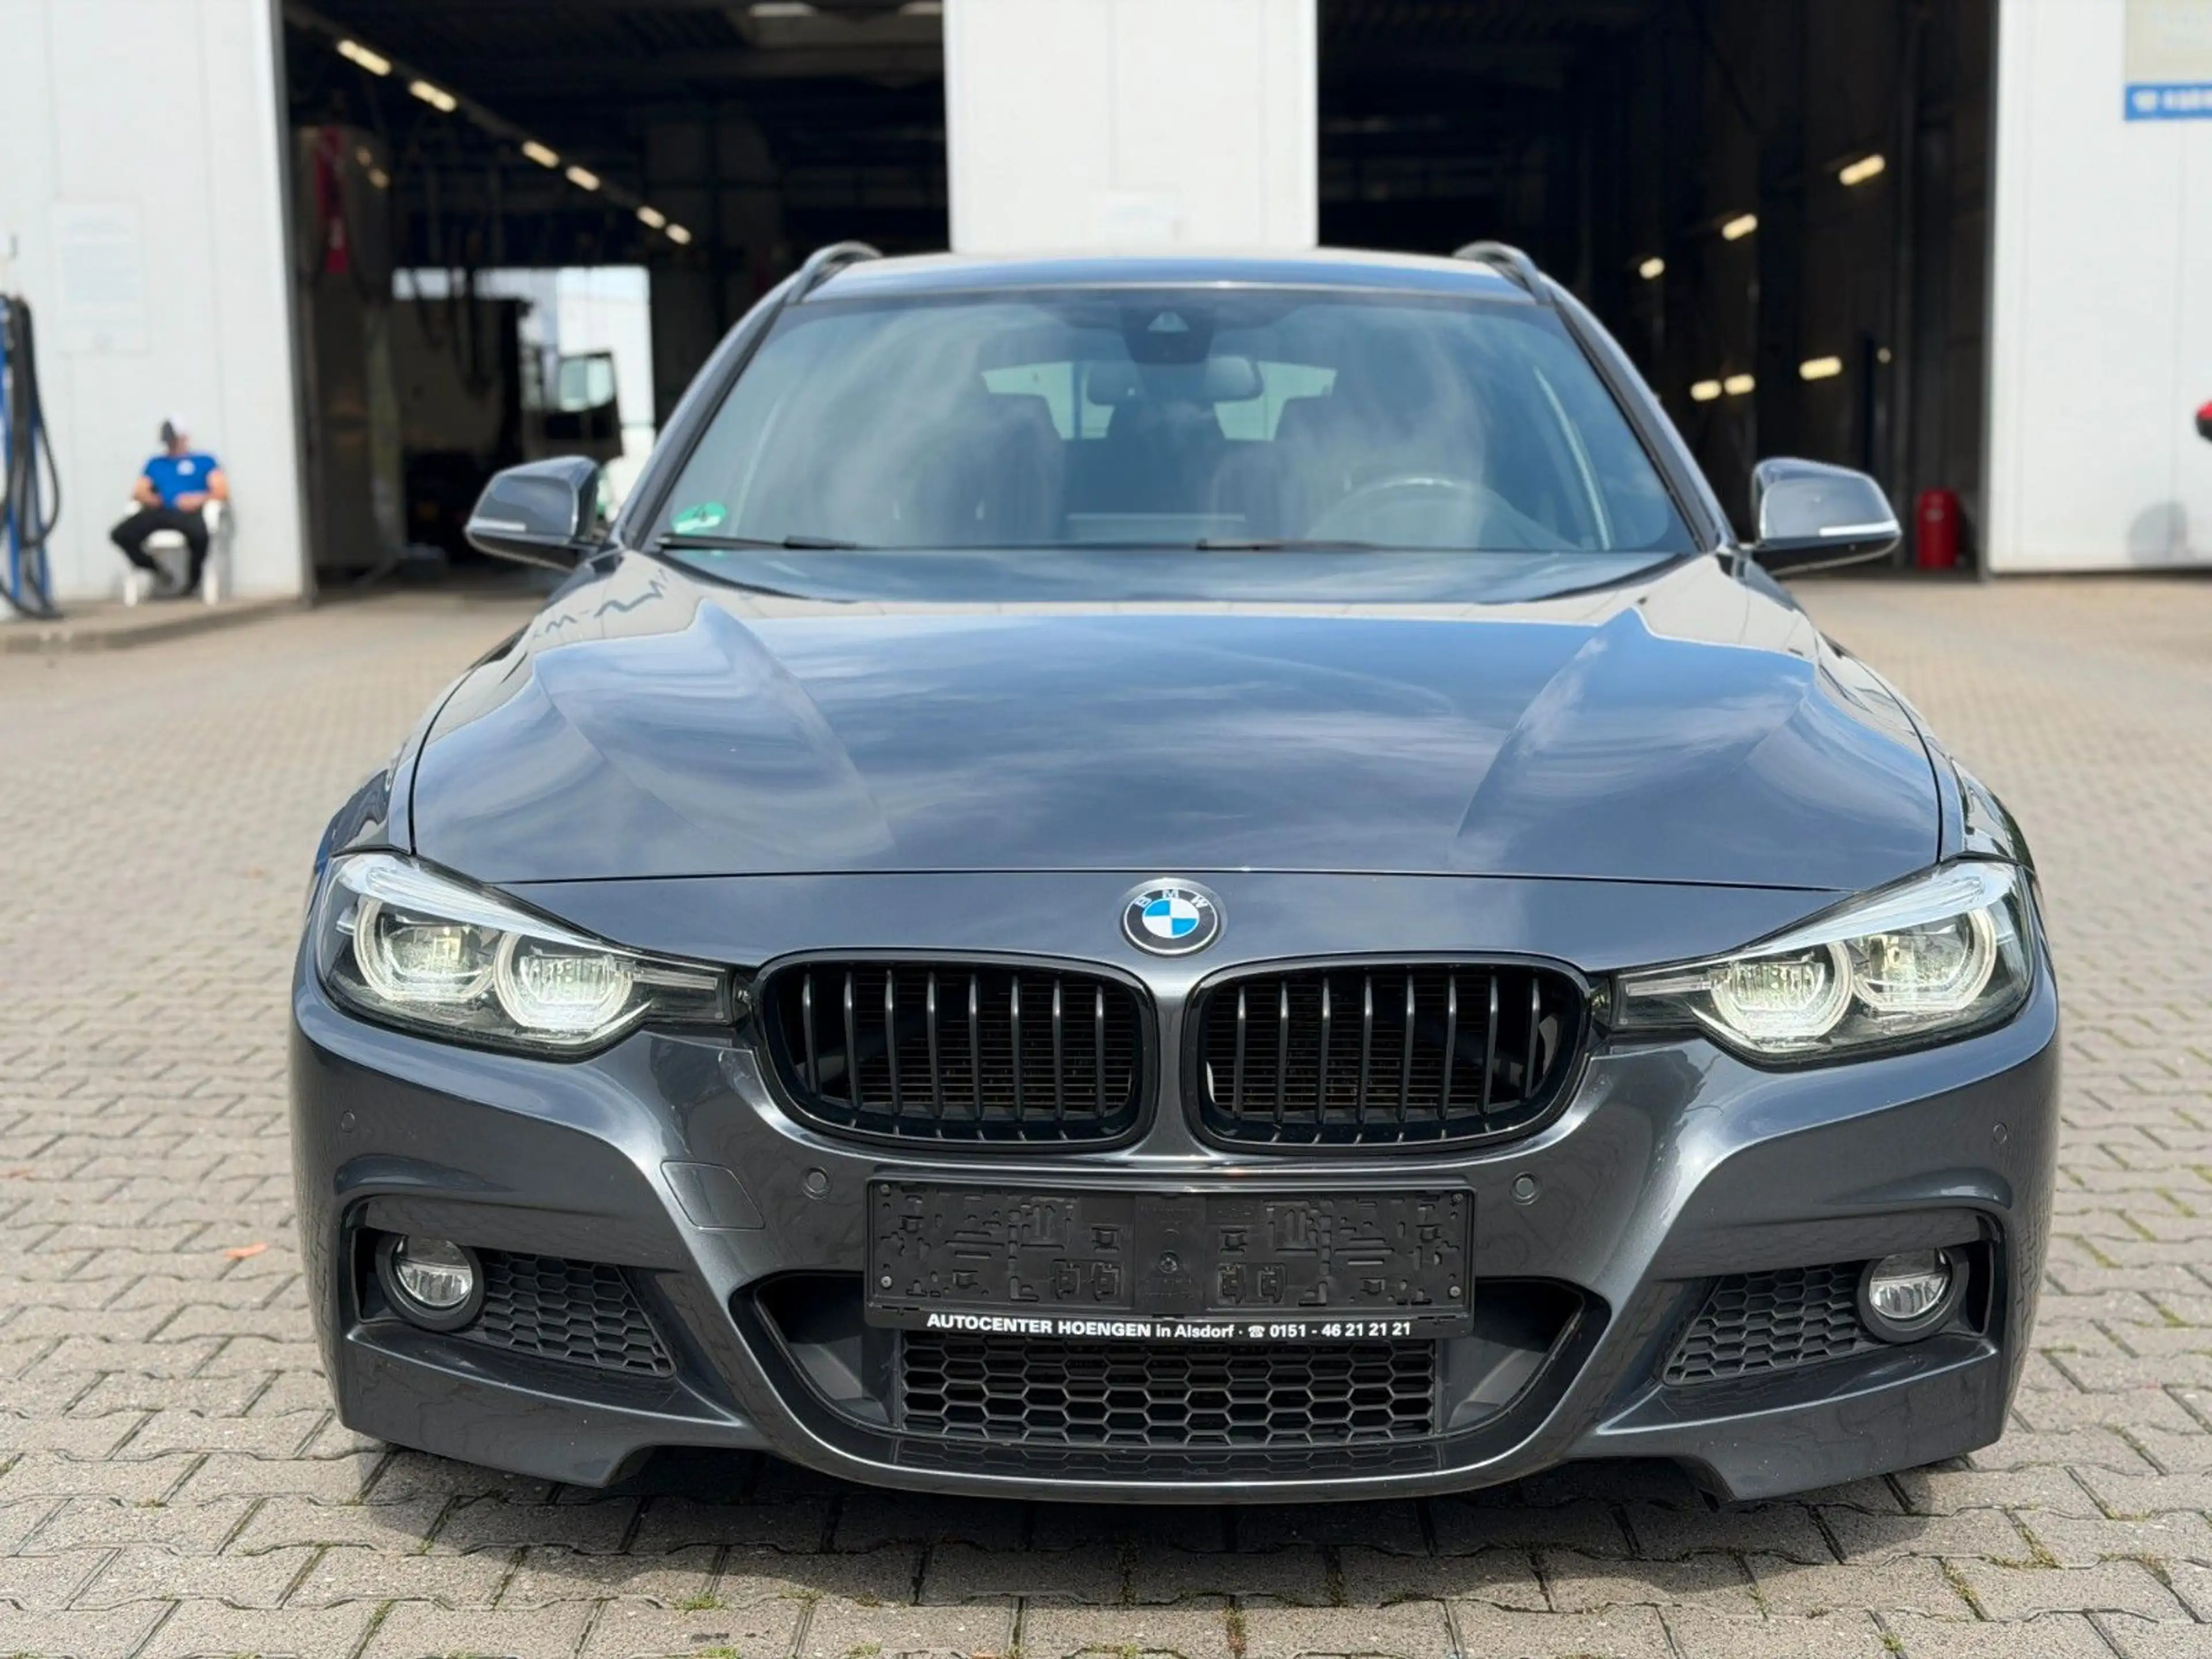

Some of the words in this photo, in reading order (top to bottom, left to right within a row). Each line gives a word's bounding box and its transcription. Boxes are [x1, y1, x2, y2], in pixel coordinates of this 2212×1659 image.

[1134, 888, 1209, 908] BMW
[926, 1313, 1053, 1334] AUTOCENTER
[1058, 1320, 1151, 1337] HOENGEN
[1156, 1324, 1172, 1338] in
[1174, 1324, 1235, 1338] Alsdorf
[1269, 1324, 1306, 1338] 0151
[1321, 1323, 1342, 1338] 46
[1344, 1323, 1363, 1337] 21
[1368, 1322, 1387, 1336] 21
[1392, 1321, 1411, 1336] 21
